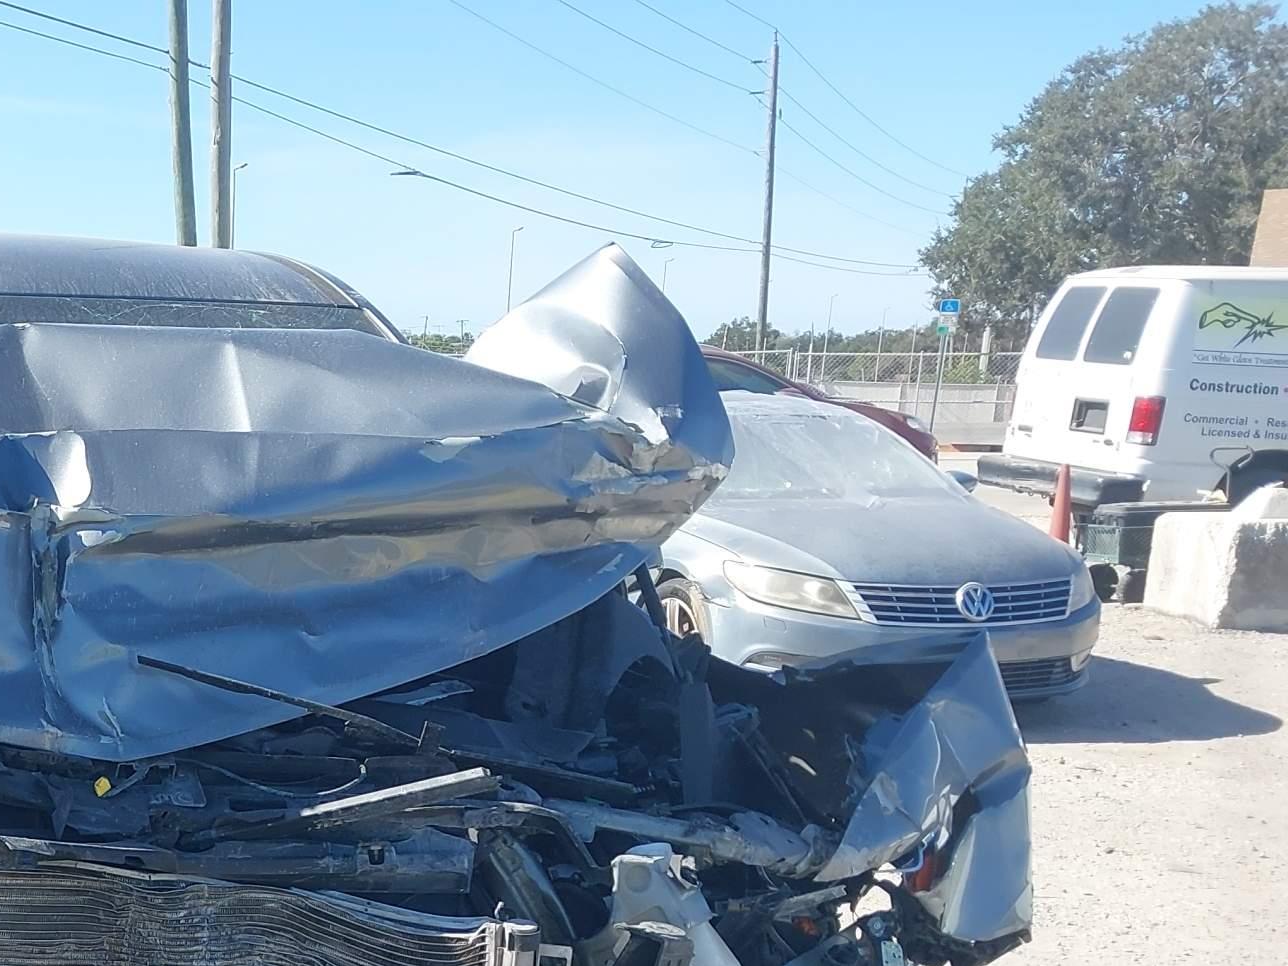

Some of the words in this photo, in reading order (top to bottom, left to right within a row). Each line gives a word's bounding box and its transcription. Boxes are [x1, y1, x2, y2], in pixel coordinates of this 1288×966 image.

[1189, 378, 1279, 395] Construction
[1184, 412, 1249, 426] Commercial
[1201, 426, 1251, 439] Licensed
[1253, 429, 1261, 439] &
